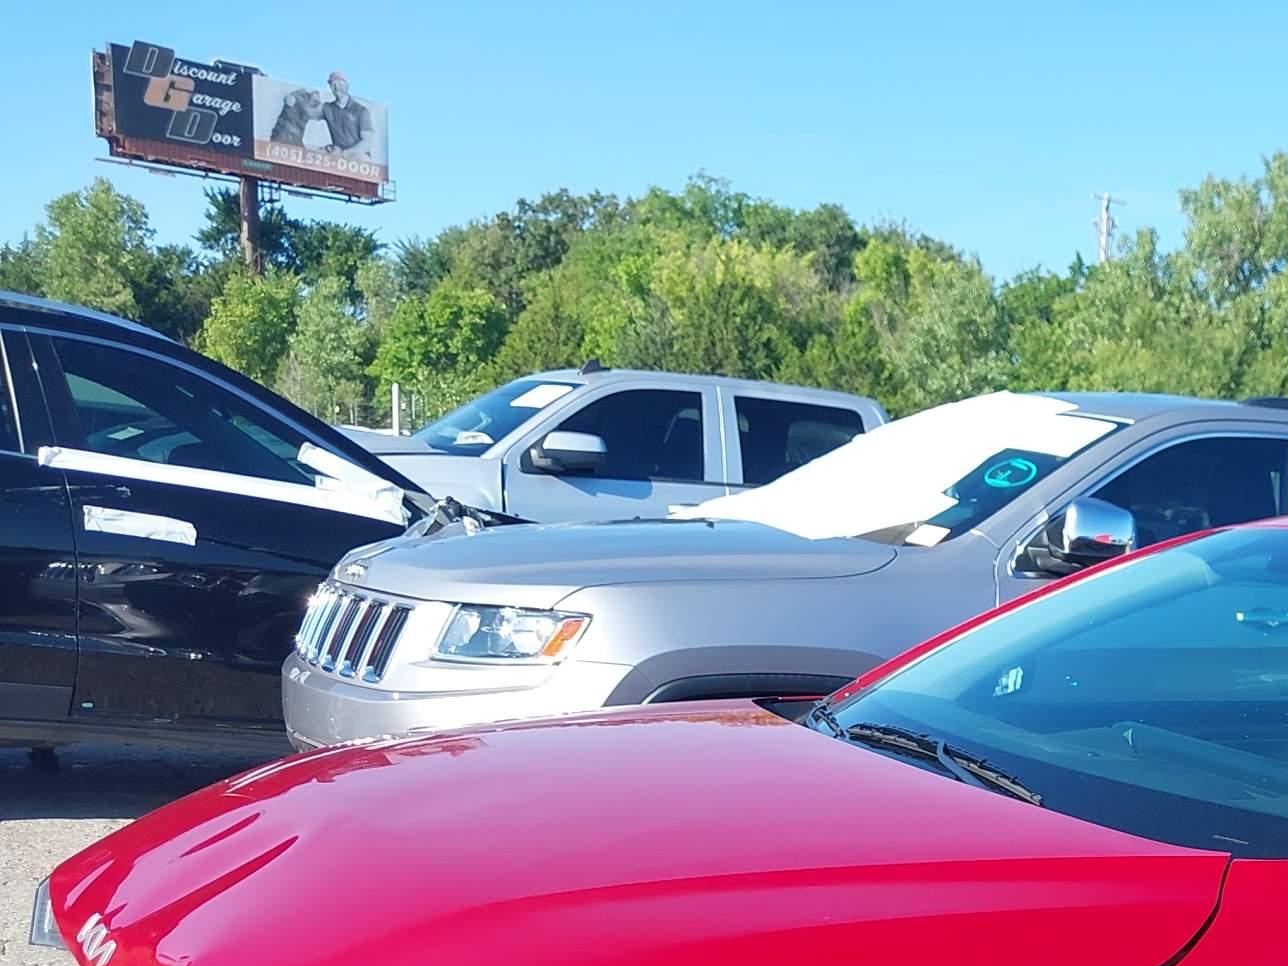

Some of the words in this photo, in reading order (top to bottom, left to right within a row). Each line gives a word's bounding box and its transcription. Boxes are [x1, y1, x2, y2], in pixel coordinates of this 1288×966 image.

[123, 40, 238, 86] Discount
[144, 75, 242, 113] Garage
[166, 107, 242, 147] Door
[304, 150, 381, 178] 525-DOOR
